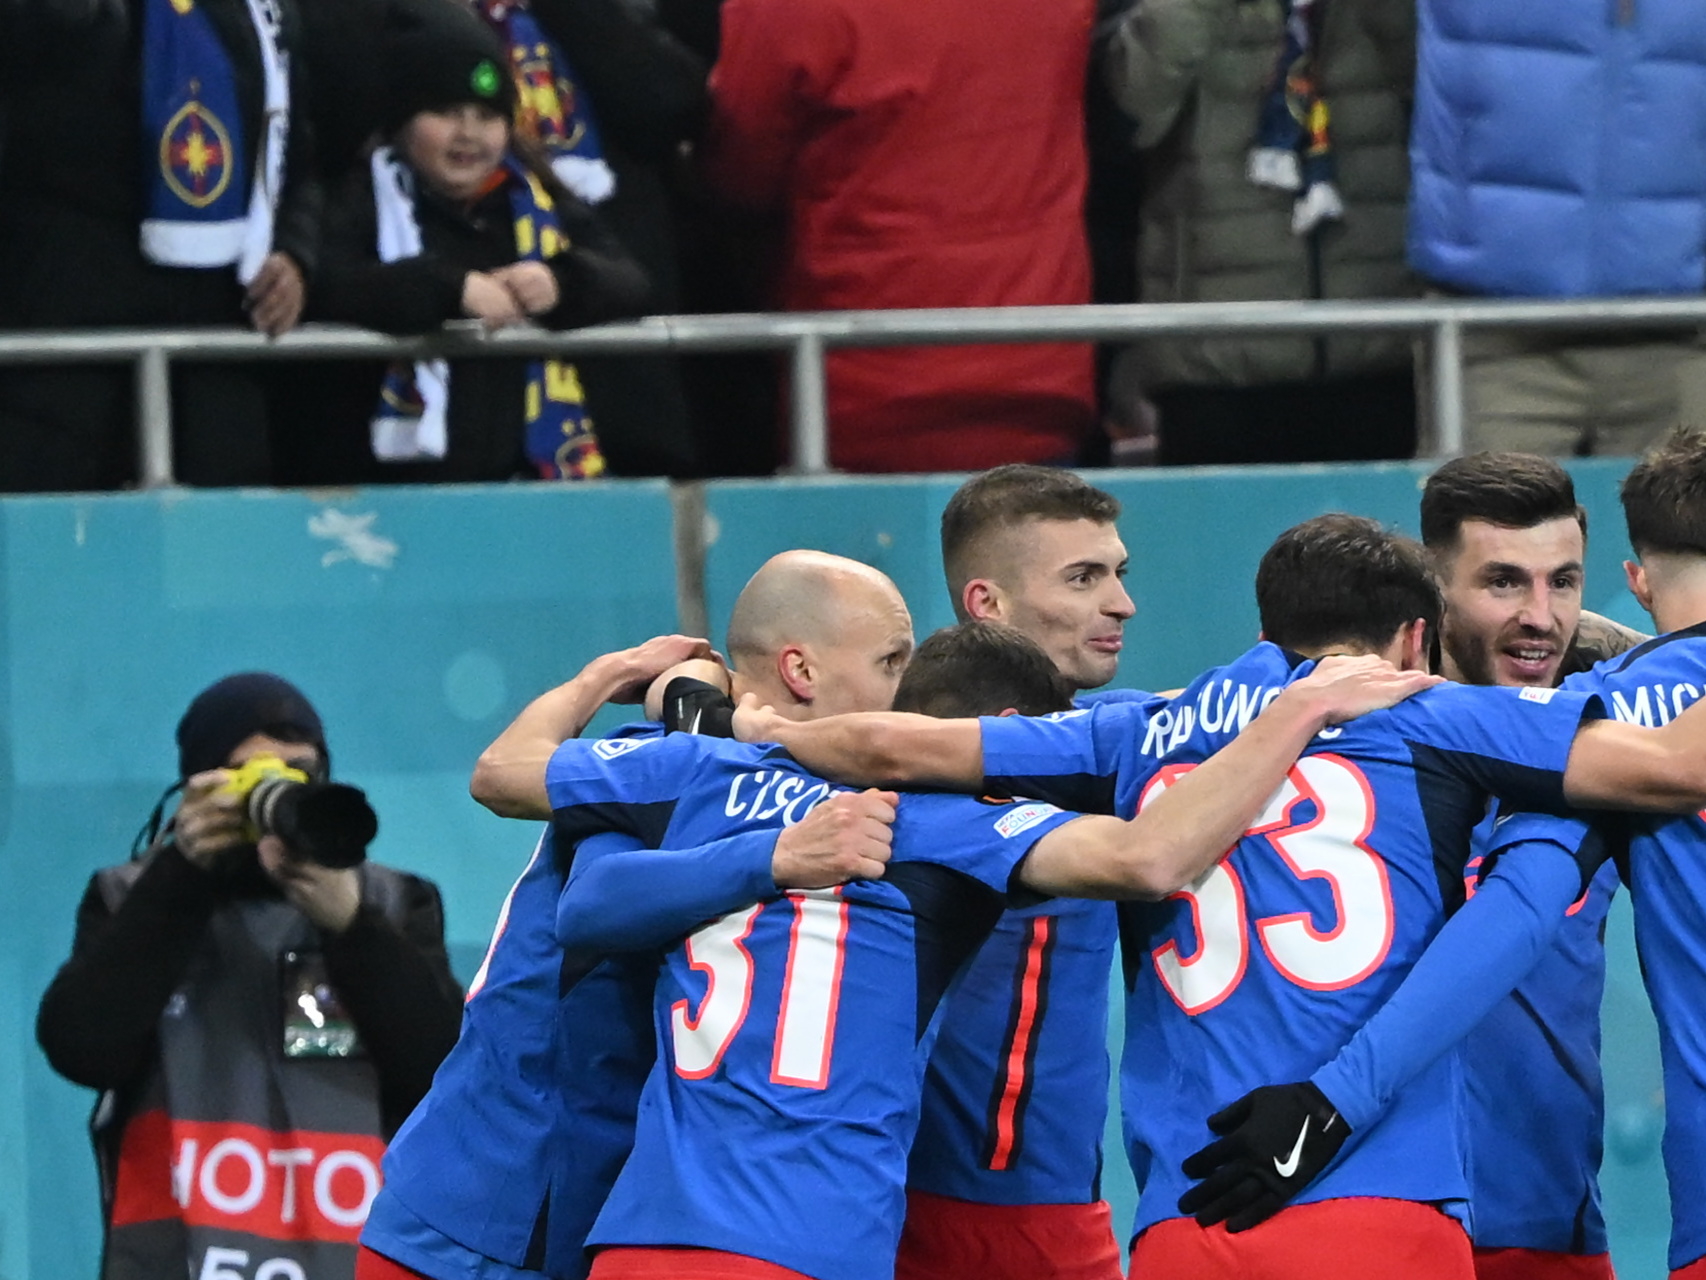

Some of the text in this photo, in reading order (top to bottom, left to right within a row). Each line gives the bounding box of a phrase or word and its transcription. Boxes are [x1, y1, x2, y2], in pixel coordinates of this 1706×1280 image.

[725, 770, 840, 828] CISO
[1135, 752, 1394, 1017] 33
[671, 886, 849, 1090] 31
[170, 1137, 381, 1227] HOTO
